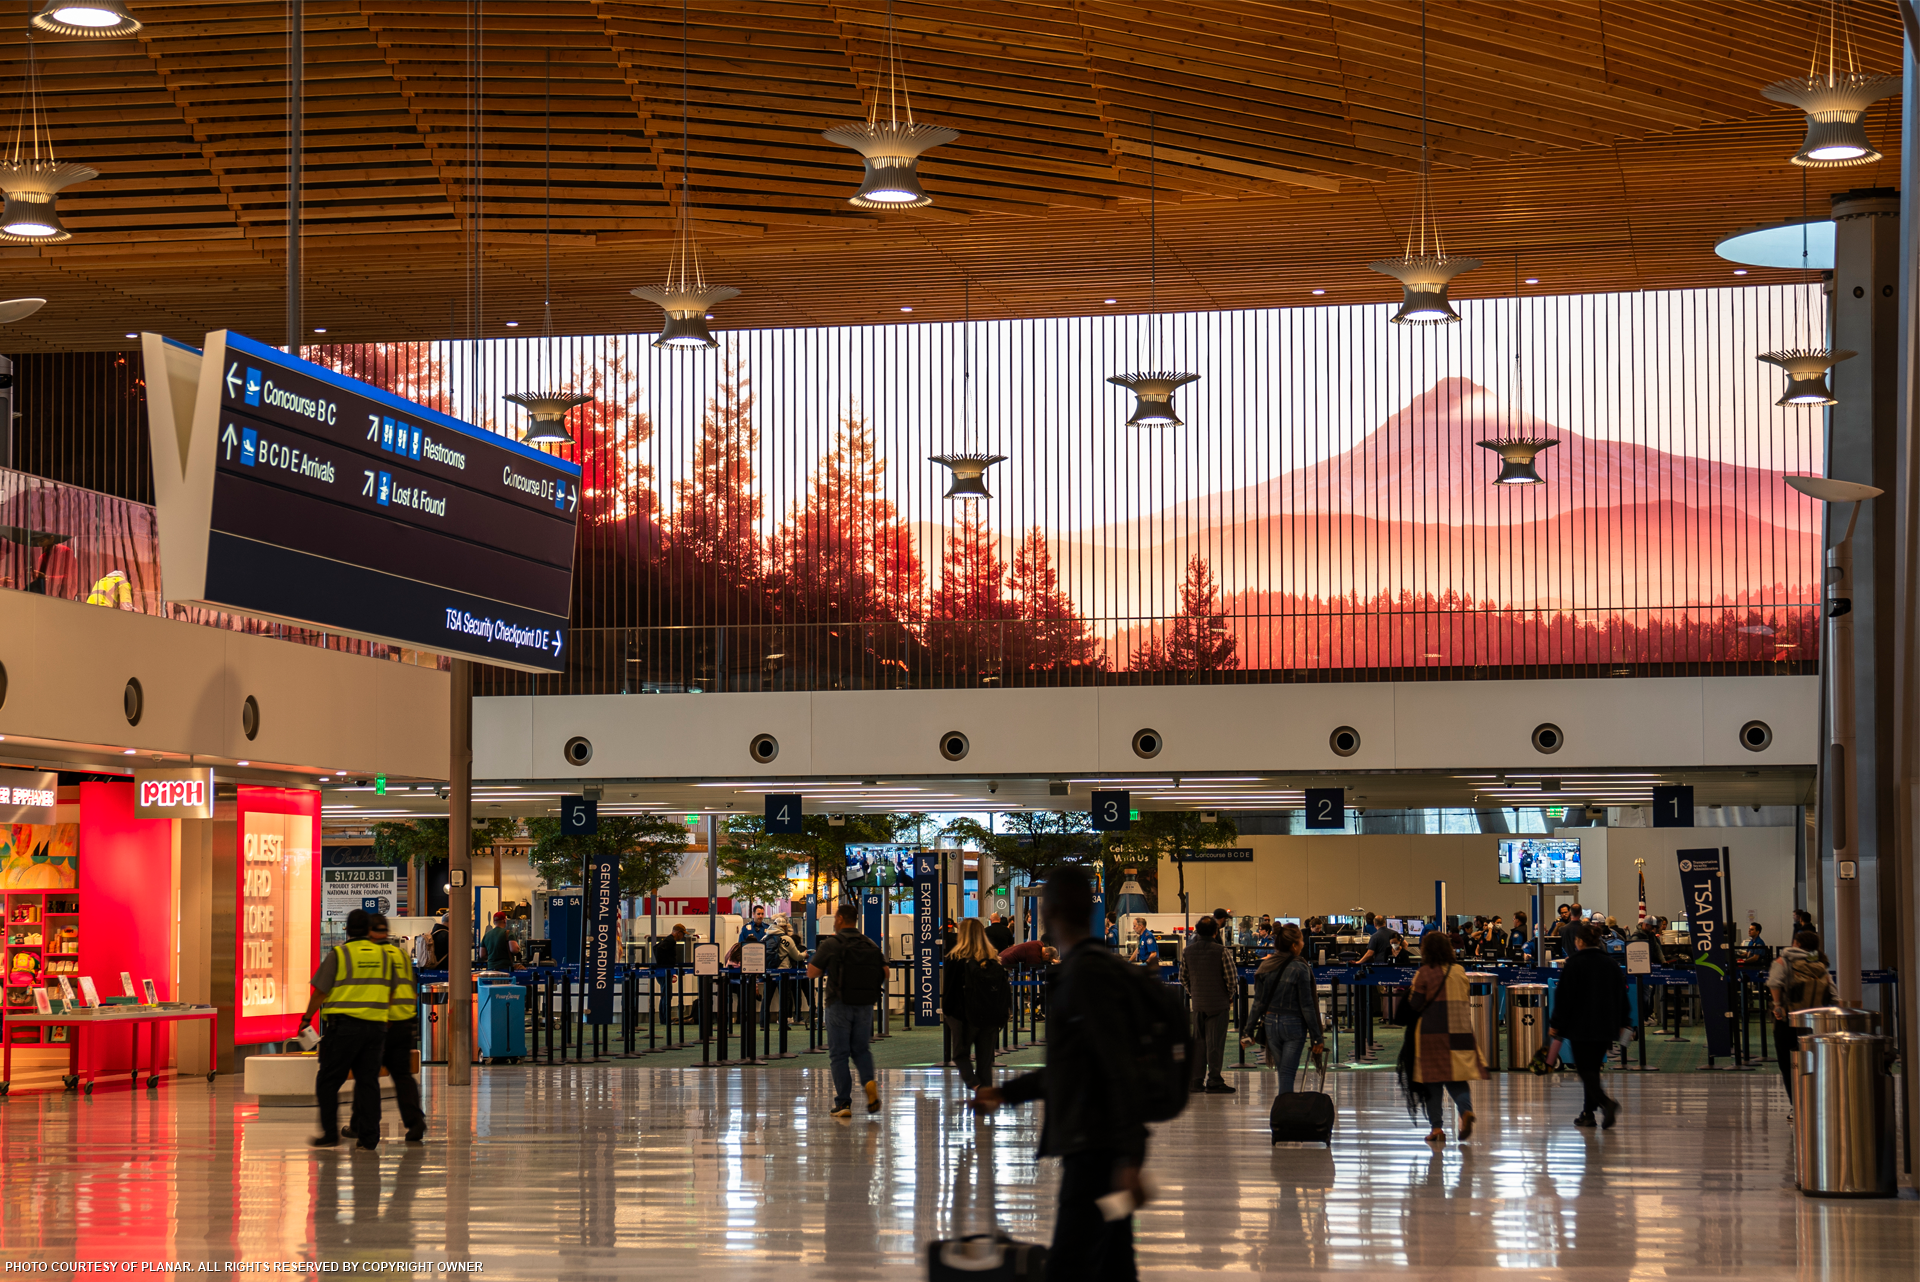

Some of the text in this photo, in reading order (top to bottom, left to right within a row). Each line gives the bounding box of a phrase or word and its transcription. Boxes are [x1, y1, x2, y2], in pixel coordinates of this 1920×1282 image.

[264, 381, 336, 425] Concourse B C
[259, 440, 335, 483] B C D E Arrivals
[423, 437, 465, 470] Restrooms
[392, 482, 446, 516] Lost & Found
[503, 466, 554, 500] Concourse D E
[446, 607, 550, 650] TSA Security Checkpoint D E
[572, 806, 586, 826] 5
[776, 804, 790, 825] 4
[1104, 801, 1118, 822] 3
[1318, 799, 1332, 820] 2
[1669, 797, 1678, 818] 1
[244, 870, 271, 897] ARD
[335, 871, 385, 881] $1,720,831
[596, 863, 611, 989] GENERAL BOARDING
[1694, 880, 1714, 951] TSA Pre
[250, 942, 273, 969] THE
[920, 883, 932, 1017] EXPRESS, EMPLOYEE
